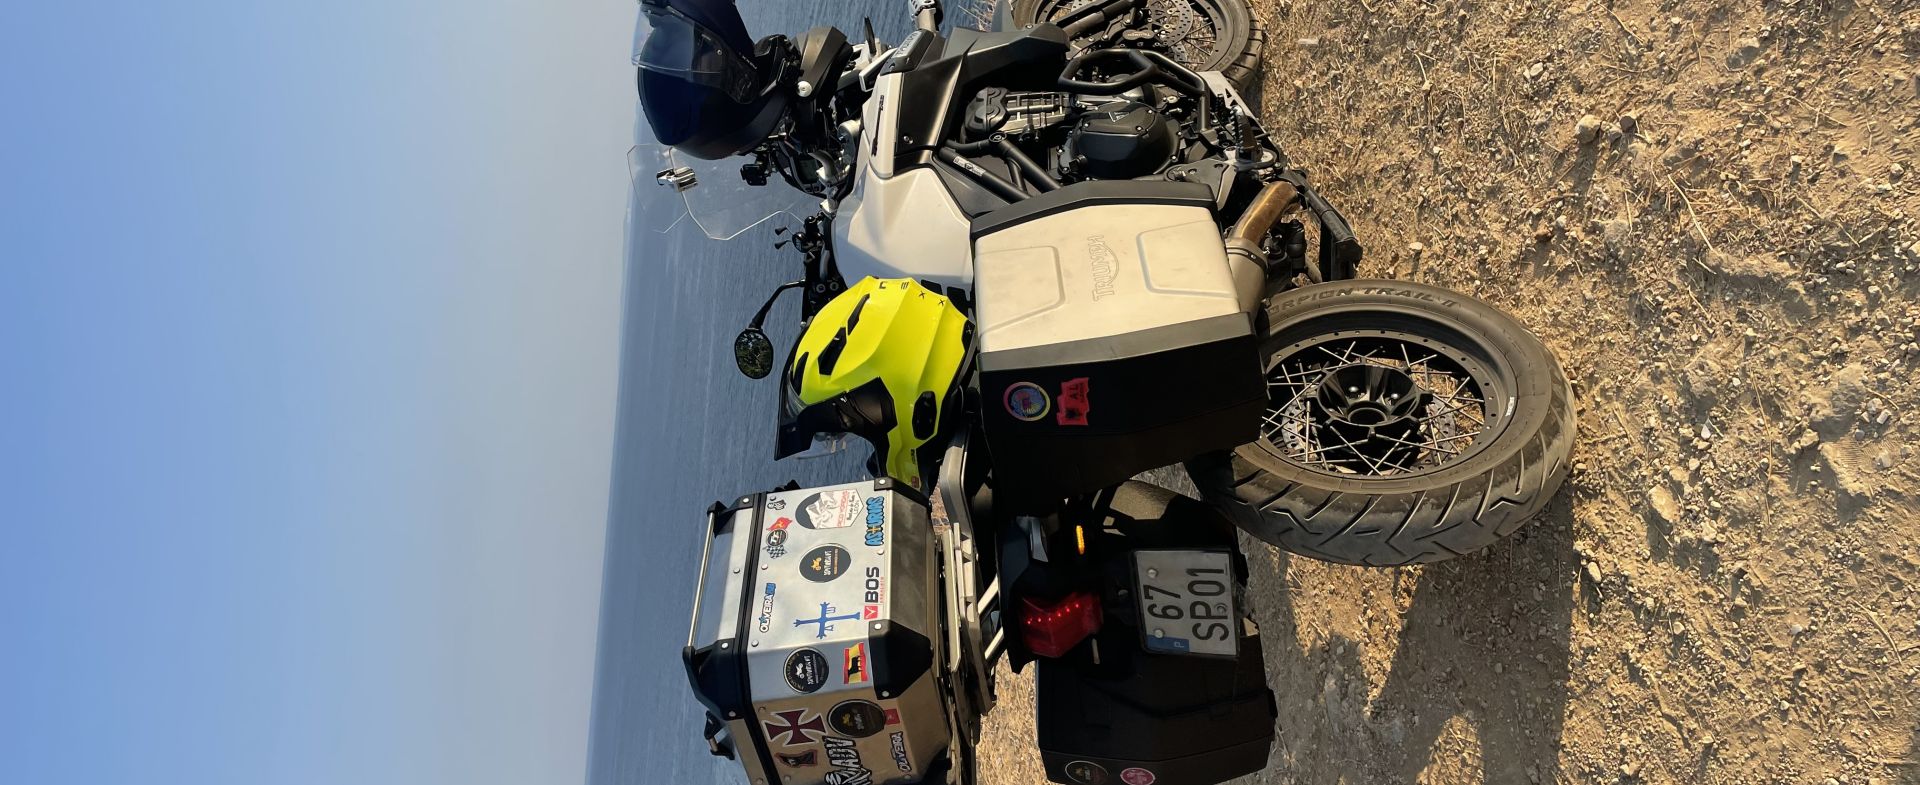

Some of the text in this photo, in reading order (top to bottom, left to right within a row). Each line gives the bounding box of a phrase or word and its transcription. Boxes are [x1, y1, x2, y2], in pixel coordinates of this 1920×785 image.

[1086, 235, 1114, 301] TRIUMPH
[1268, 288, 1352, 314] ORPION
[865, 567, 879, 603] BOS
[1143, 584, 1184, 619] 67
